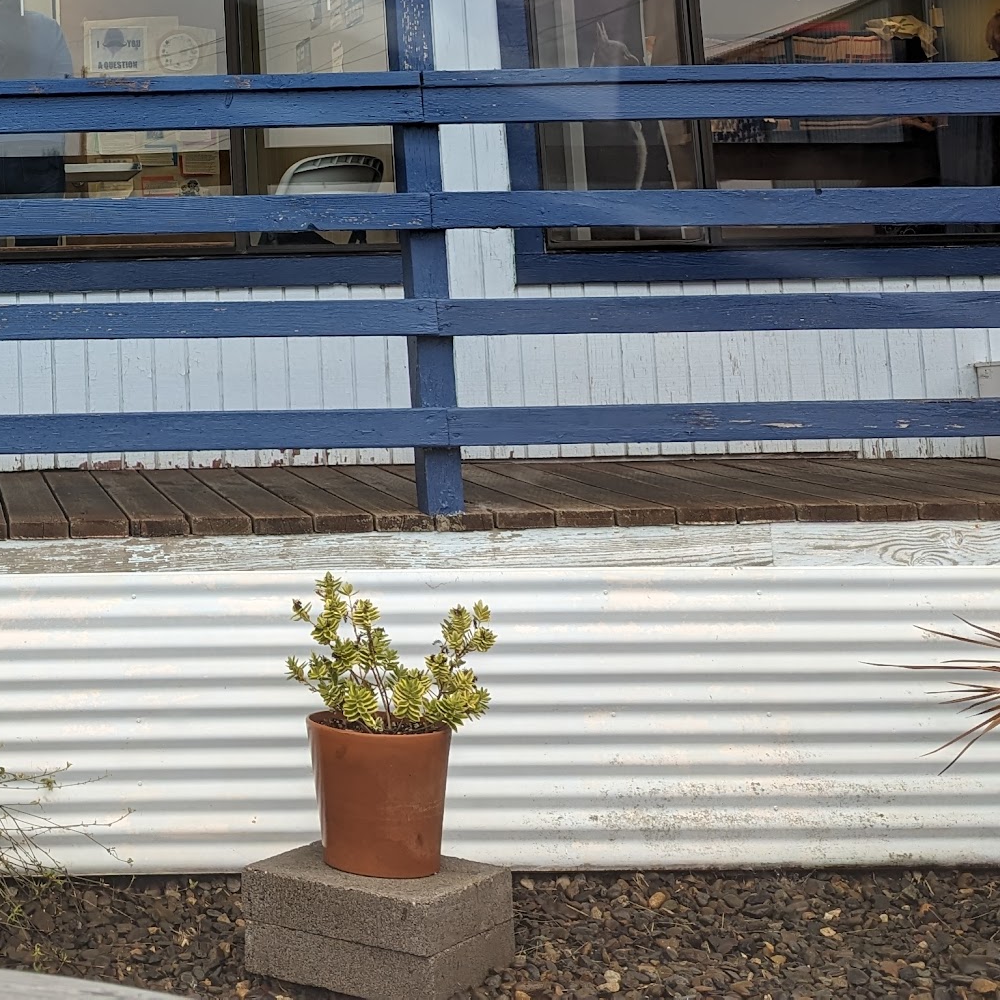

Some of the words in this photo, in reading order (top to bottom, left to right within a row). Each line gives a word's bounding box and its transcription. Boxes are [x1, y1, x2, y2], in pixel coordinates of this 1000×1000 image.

[96, 40, 100, 48] I
[127, 40, 141, 48] YOU
[98, 61, 103, 69] A
[104, 61, 138, 69] QUESTION
